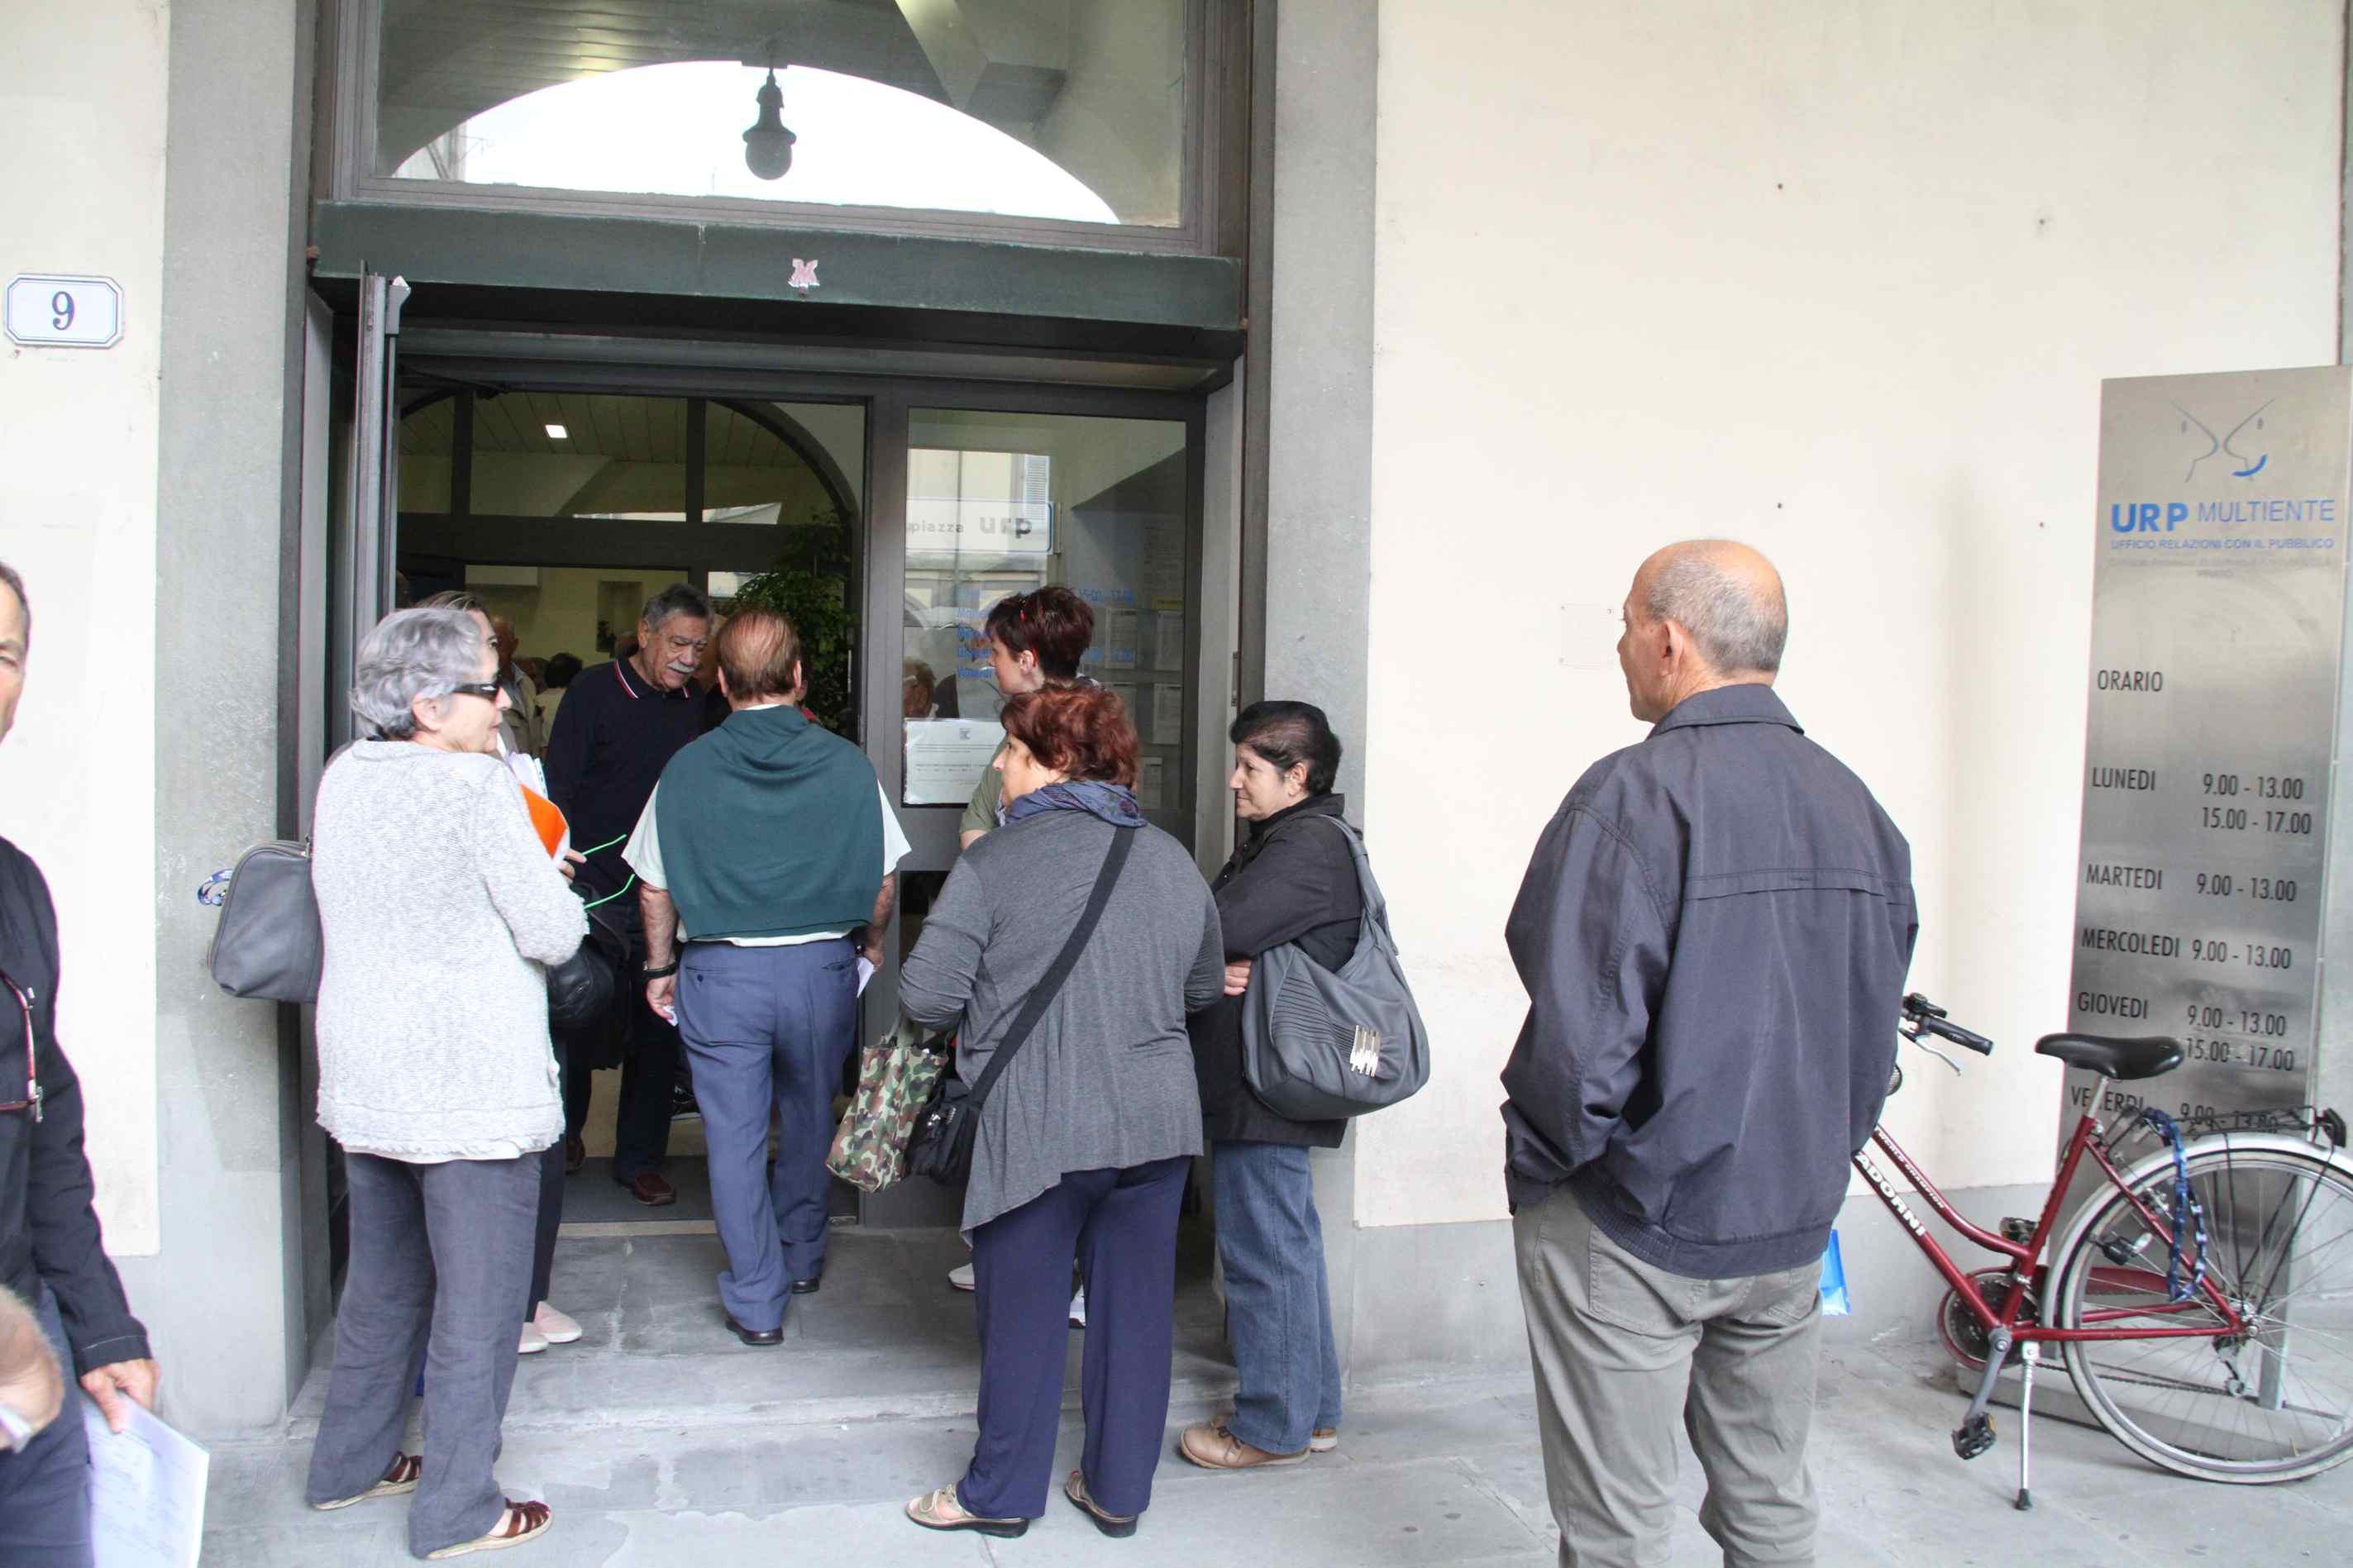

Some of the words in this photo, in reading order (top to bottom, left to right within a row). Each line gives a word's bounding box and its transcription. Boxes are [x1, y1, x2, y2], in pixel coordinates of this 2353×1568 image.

[51, 290, 75, 331] 9
[2111, 502, 2189, 533] URP
[2196, 499, 2336, 523] MULTIENTE
[2111, 538, 2156, 550] UFFICIO
[2159, 538, 2222, 550] RELAZIONI
[2223, 538, 2250, 550] CON
[2268, 537, 2335, 549] PUBBLICO
[2097, 670, 2163, 692] ORARIO
[2092, 767, 2155, 790] LUNEDI
[2203, 774, 2238, 796] 9.00
[2257, 776, 2304, 800] 13.00
[2202, 807, 2247, 830] 15.00
[2265, 811, 2312, 835] 17.00
[2085, 864, 2162, 890] MARTEDI
[2196, 873, 2231, 897] 9.00
[2250, 877, 2297, 903] 13.00
[2081, 927, 2180, 958] MERCOLEDI
[2192, 939, 2227, 962] 9.00
[2246, 944, 2292, 970] 13.00
[2077, 992, 2148, 1019] GIOVEDI
[2187, 1004, 2222, 1029] 9.00
[2241, 1010, 2287, 1037] 13.00
[2186, 1037, 2230, 1063] 15.00
[2250, 1045, 2295, 1072] 17.00
[2071, 1085, 2144, 1113] VEERDI
[1854, 1153, 1926, 1237] ADORNI
